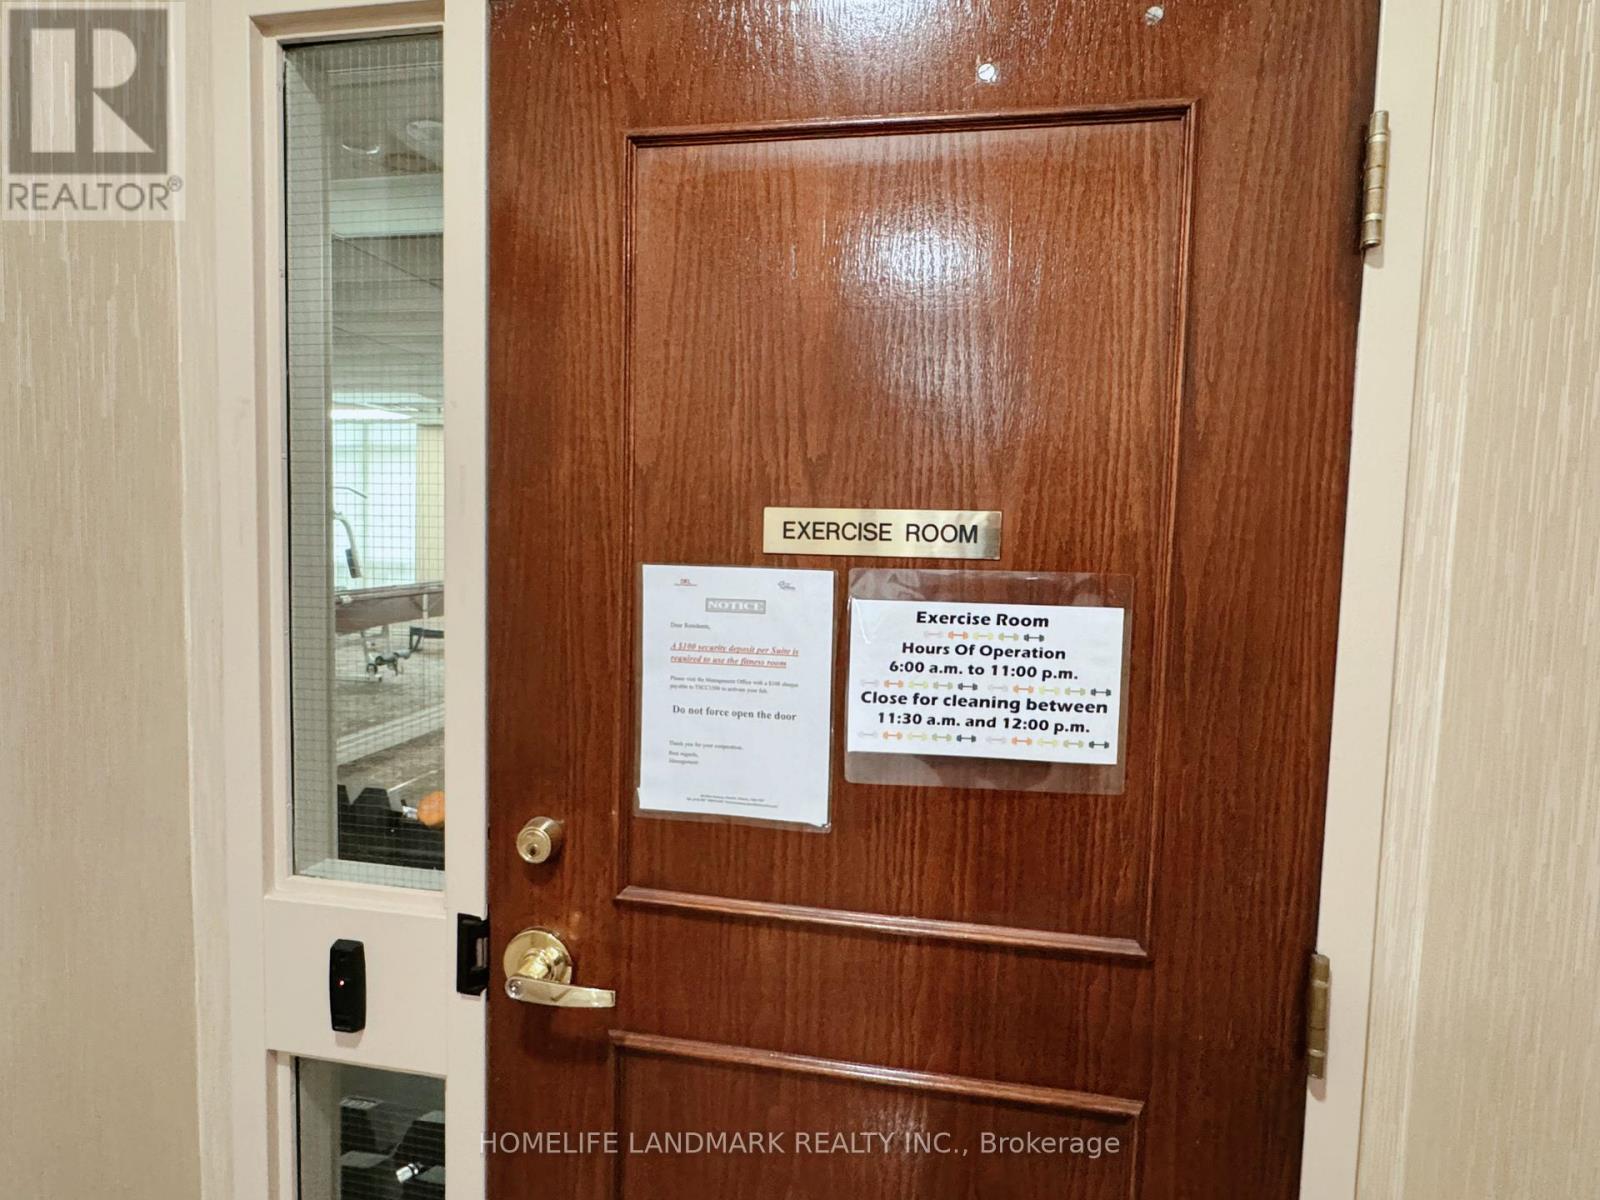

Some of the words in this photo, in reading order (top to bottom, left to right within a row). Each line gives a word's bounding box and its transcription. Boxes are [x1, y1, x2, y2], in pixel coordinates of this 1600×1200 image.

[783, 521, 892, 541] EXERCISE
[906, 524, 978, 544] ROOM
[706, 600, 765, 613] NOTICE
[916, 611, 991, 626] Exercise
[996, 613, 1049, 628] Room
[678, 642, 697, 651] $100
[698, 644, 726, 653] security
[728, 645, 755, 654] deposit
[756, 647, 770, 656] per
[771, 646, 791, 656] Suite
[792, 648, 799, 656] is
[902, 642, 950, 656] Hours
[955, 643, 976, 656] Of
[980, 645, 1066, 660] Operation
[671, 654, 702, 664] required
[703, 656, 711, 664] to
[712, 657, 725, 665] use
[726, 656, 739, 666] the
[767, 660, 787, 668] room
[889, 661, 925, 674] 6:00
[929, 664, 963, 675] a.m.
[968, 664, 985, 676] to
[991, 664, 1037, 678] 11:00
[1041, 667, 1078, 682] p.m.
[861, 691, 908, 705] Close
[913, 692, 937, 707] for
[943, 694, 1021, 713] cleaning
[1026, 698, 1108, 714] between
[672, 704, 686, 714] Do
[688, 706, 704, 715] not
[705, 706, 730, 717] force
[731, 710, 754, 720] open
[756, 709, 772, 720] the
[774, 711, 797, 721] door
[878, 712, 922, 725] 11:30
[927, 715, 960, 727] a.m.
[965, 716, 996, 728] and
[1003, 717, 1049, 732] 12:00
[1053, 720, 1090, 735] p.m.
